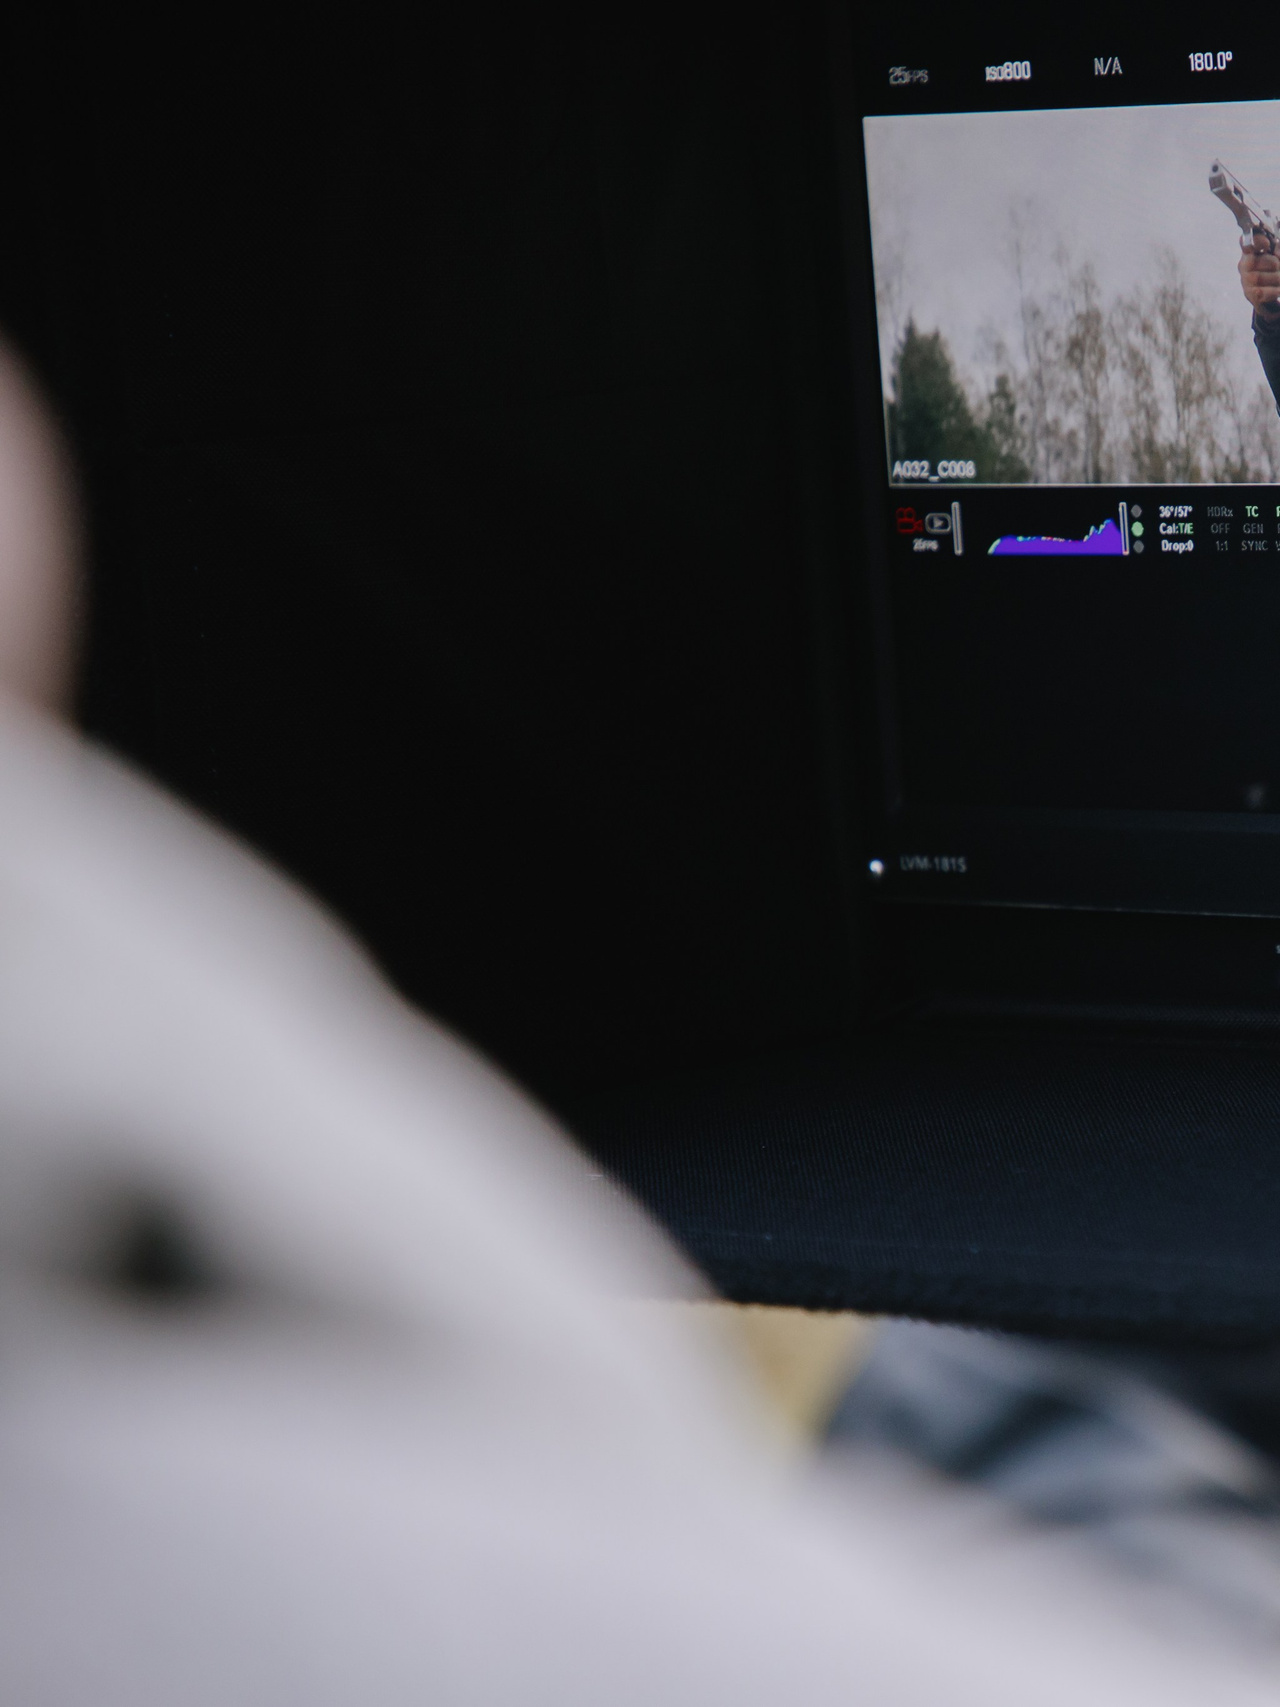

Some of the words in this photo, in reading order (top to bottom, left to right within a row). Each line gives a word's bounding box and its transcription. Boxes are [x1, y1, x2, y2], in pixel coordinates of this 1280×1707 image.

[1094, 57, 1123, 76] N/A
[1245, 506, 1259, 517] TC
[1210, 524, 1230, 534] OFF
[1243, 523, 1264, 534] GEN
[1215, 540, 1229, 551] 1:1
[1241, 540, 1268, 551] SYNC
